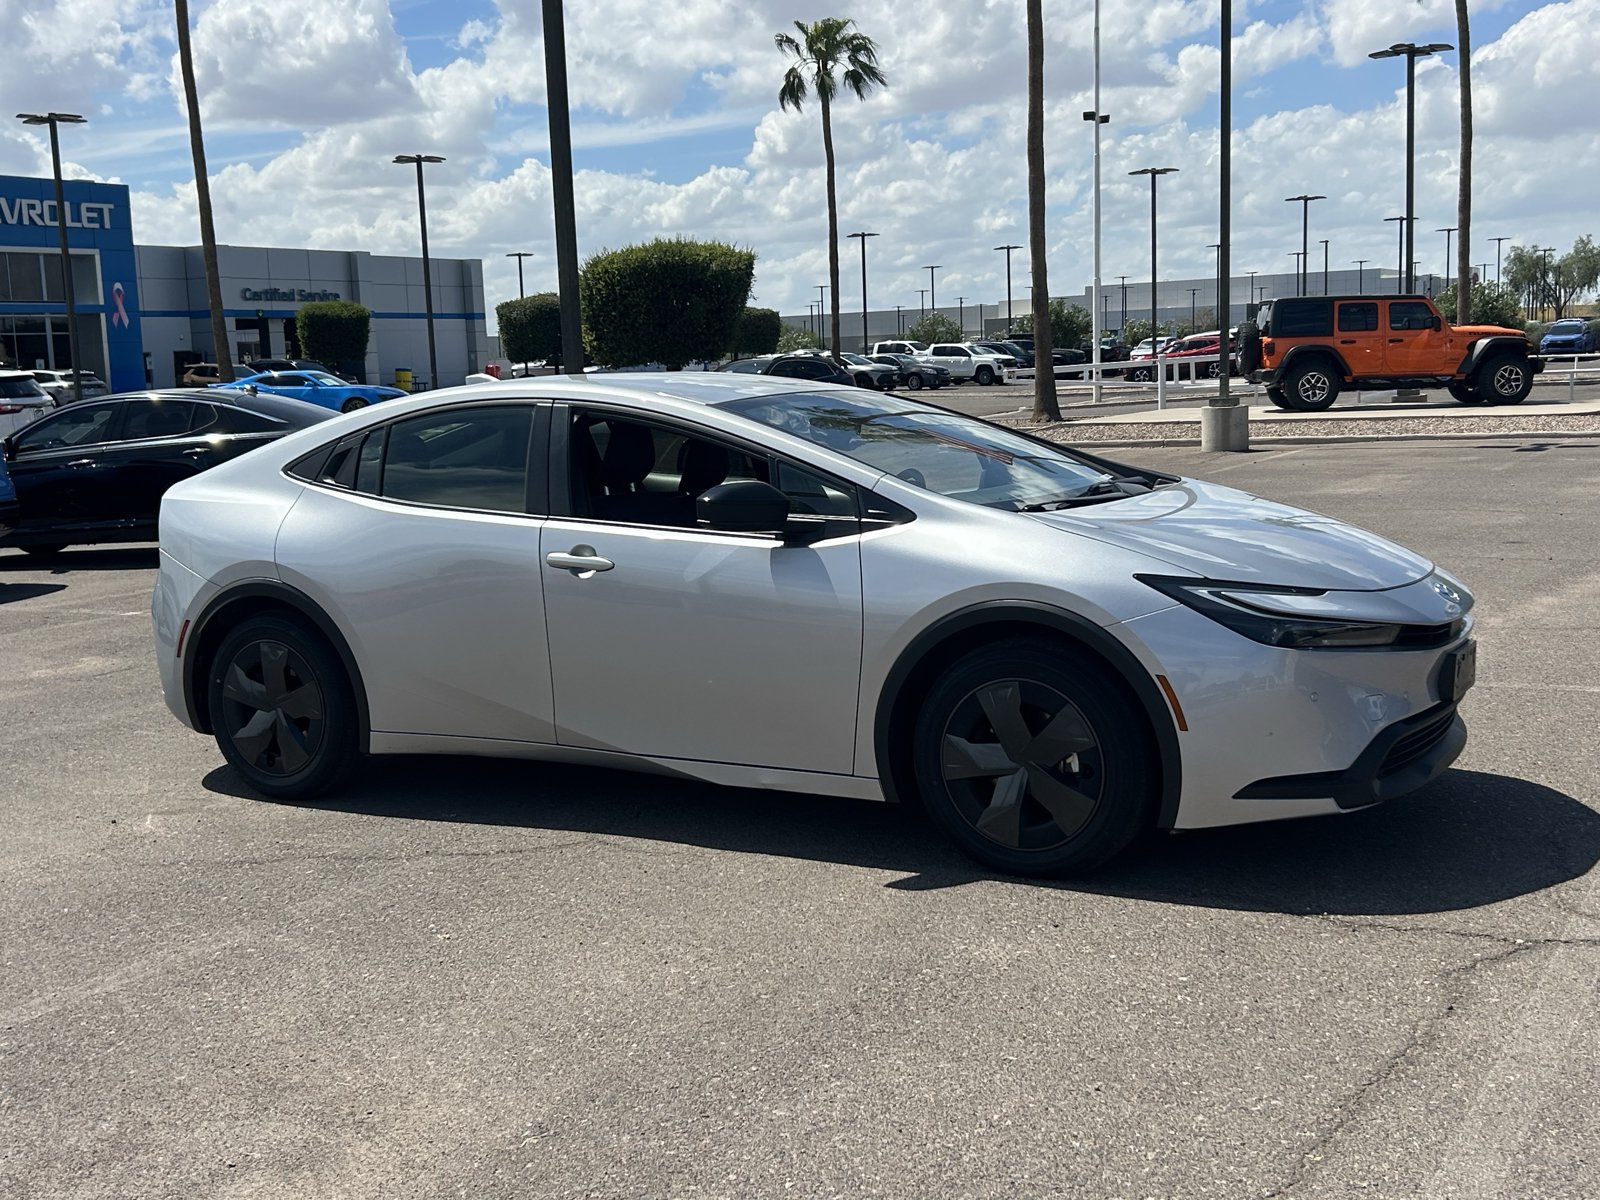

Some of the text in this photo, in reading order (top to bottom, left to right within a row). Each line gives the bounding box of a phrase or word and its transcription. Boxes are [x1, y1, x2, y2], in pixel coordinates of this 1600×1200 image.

[0, 197, 114, 229] VROLET
[241, 287, 341, 301] Certified Service
